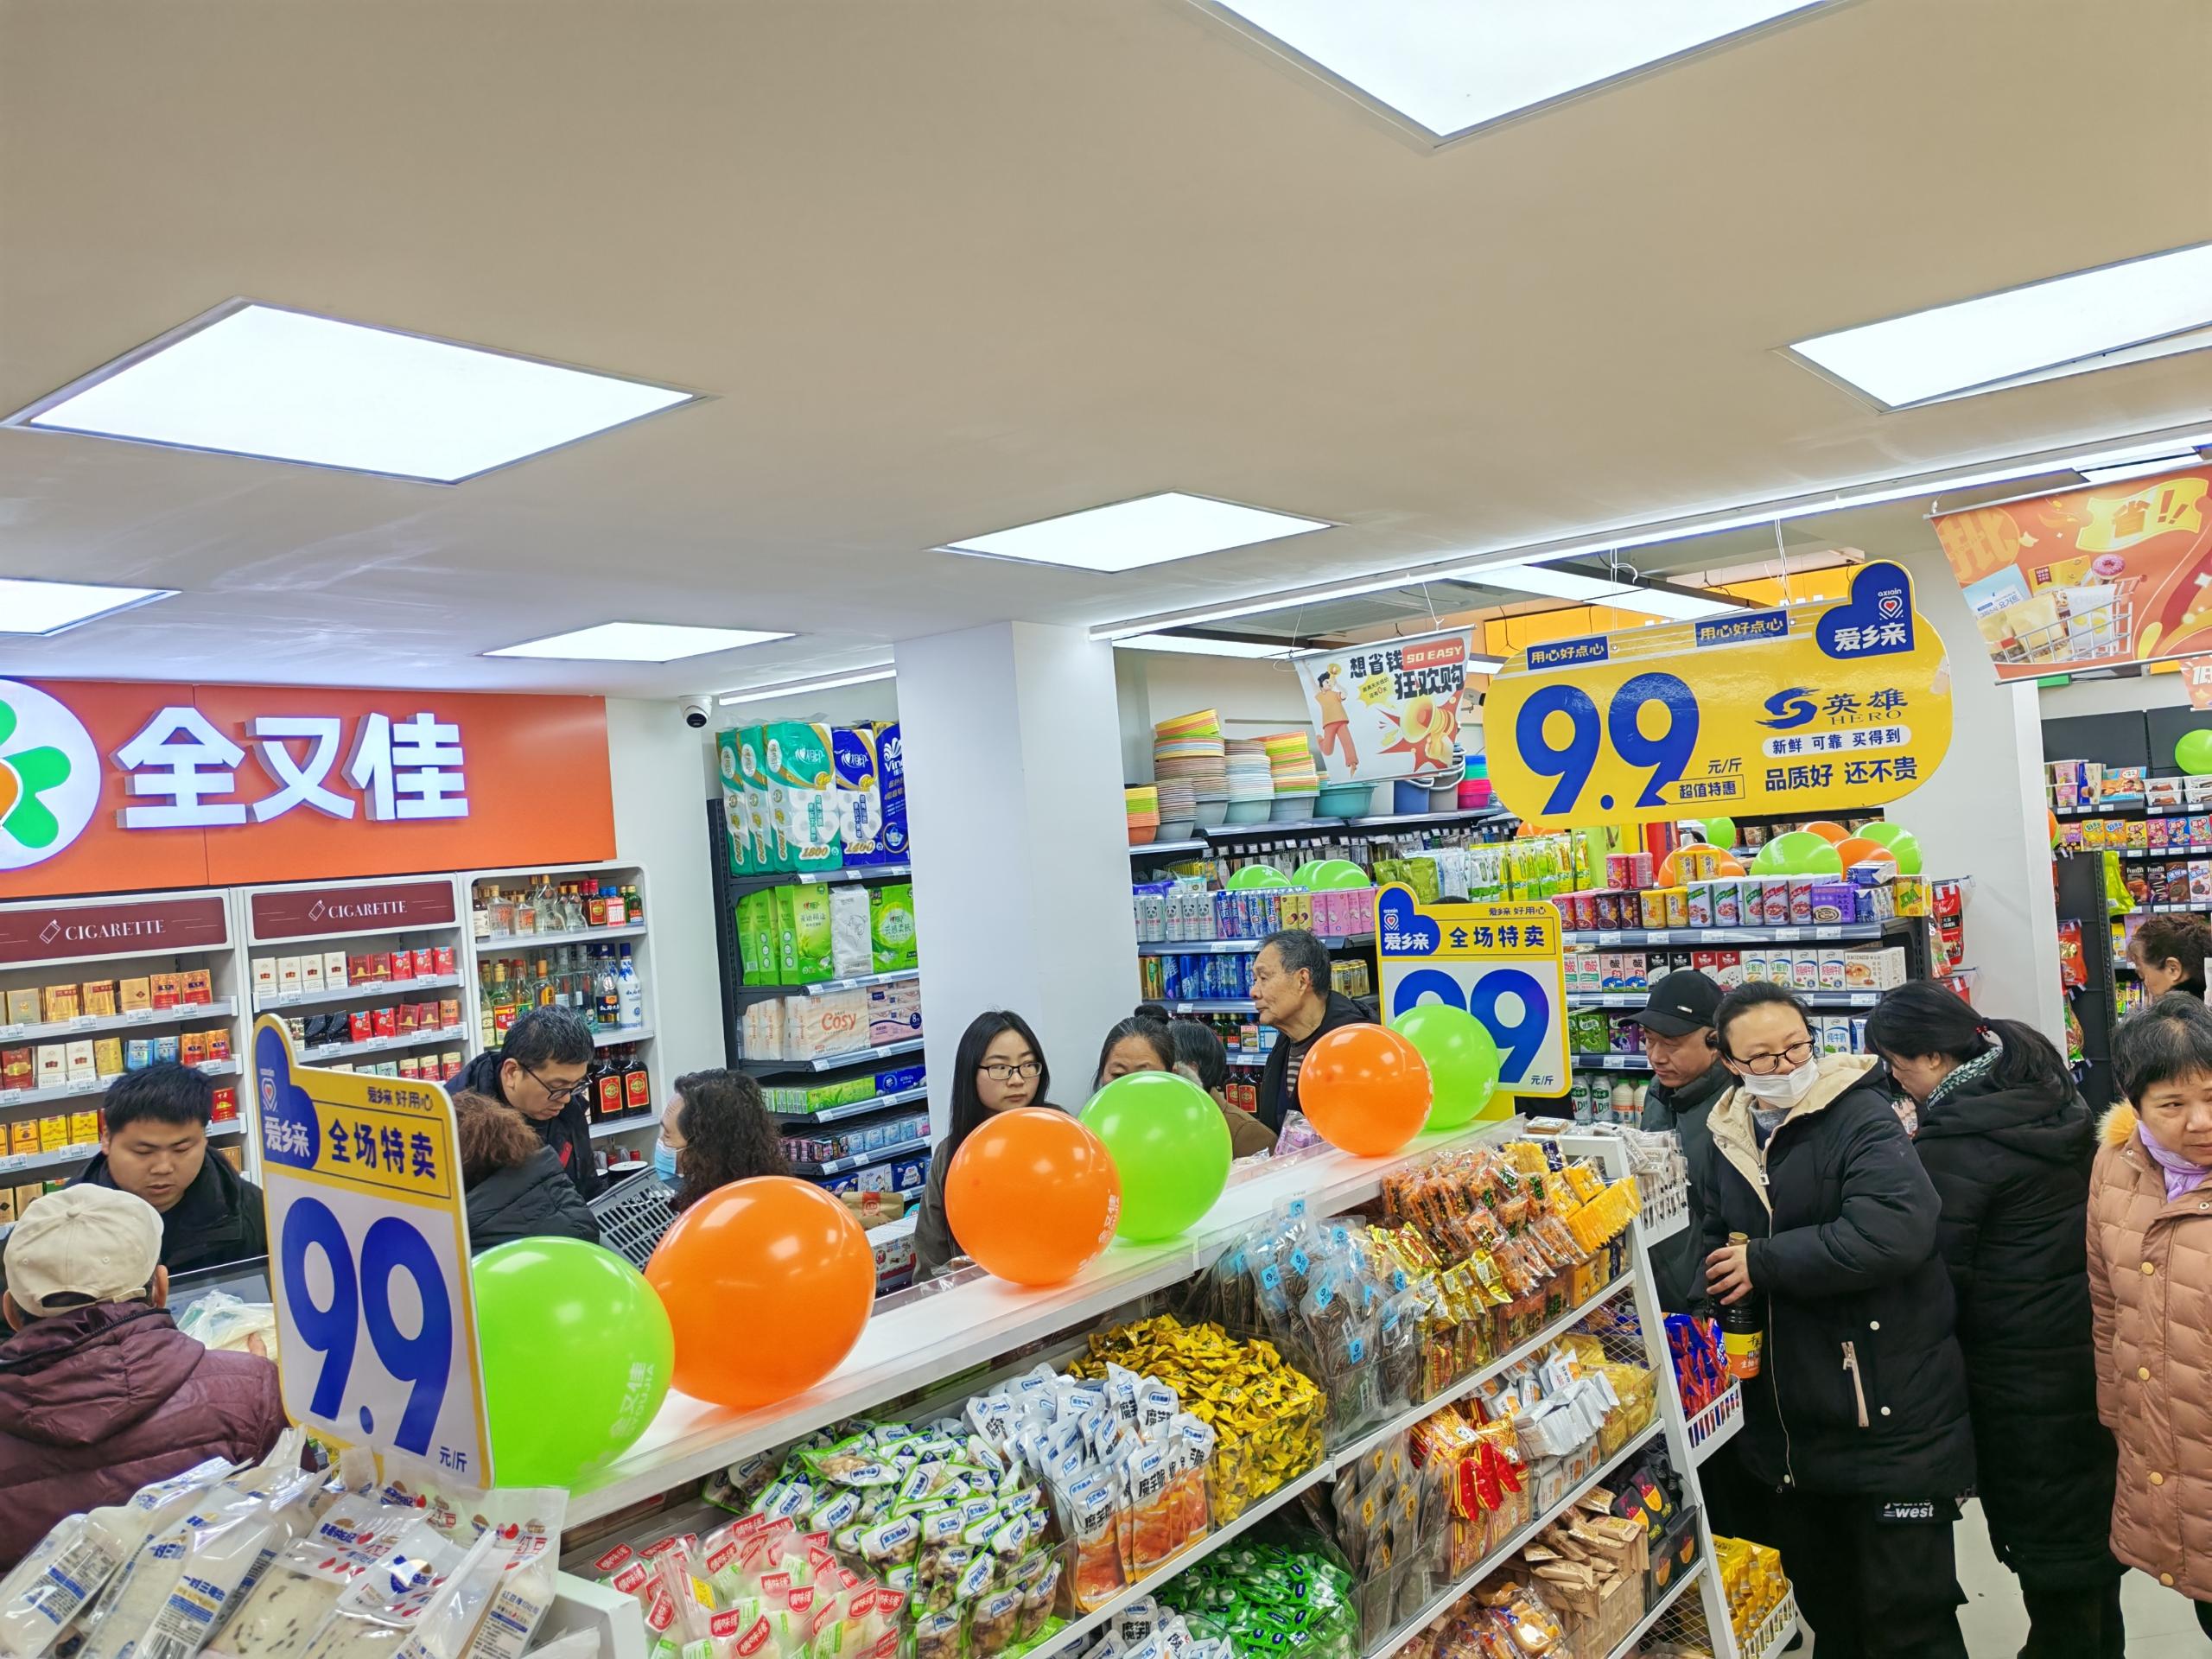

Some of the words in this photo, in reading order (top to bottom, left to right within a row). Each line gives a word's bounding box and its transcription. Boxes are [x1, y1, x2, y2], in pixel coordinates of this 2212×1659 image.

[1700, 618, 1785, 640] 用心好点心
[1834, 622, 1907, 652] 爱乡亲
[1350, 650, 1403, 678] 想省钱
[1407, 653, 1424, 664] SO
[1427, 645, 1463, 660] EASY
[1530, 643, 1605, 664] 用心好点心
[1394, 664, 1465, 700] 狂欢购
[1822, 688, 1908, 715] 英雄
[1832, 709, 1902, 725] HERO
[1772, 737, 1802, 754] 新鲜
[1812, 734, 1842, 750] 可靠
[1853, 728, 1900, 747] 买得到
[115, 706, 469, 829] 全又佳
[1707, 757, 1743, 775] 元/斤
[1765, 764, 1833, 791] 品质好
[1844, 756, 1917, 785] 还不贵
[1679, 780, 1738, 801] 超值特惠
[801, 848, 829, 858] 1800
[328, 900, 408, 919] CIGARETTE
[1489, 907, 1510, 916] 爱乡亲
[1513, 906, 1547, 916] 好用心
[65, 918, 167, 943] CIGARETTE
[1384, 932, 1430, 950] 爱乡亲
[1449, 925, 1545, 949] 全场特卖
[822, 1012, 857, 1032] Cosy
[1530, 1075, 1554, 1086] 元/斤
[396, 1090, 434, 1112] 好用心
[264, 1116, 311, 1158] 爱乡亲
[328, 1118, 436, 1179] 全场特卖
[282, 1197, 454, 1457] 9.9
[608, 1362, 646, 1440] 全又佳
[440, 1446, 468, 1473] 元/斤
[1895, 1504, 1935, 1518] west
